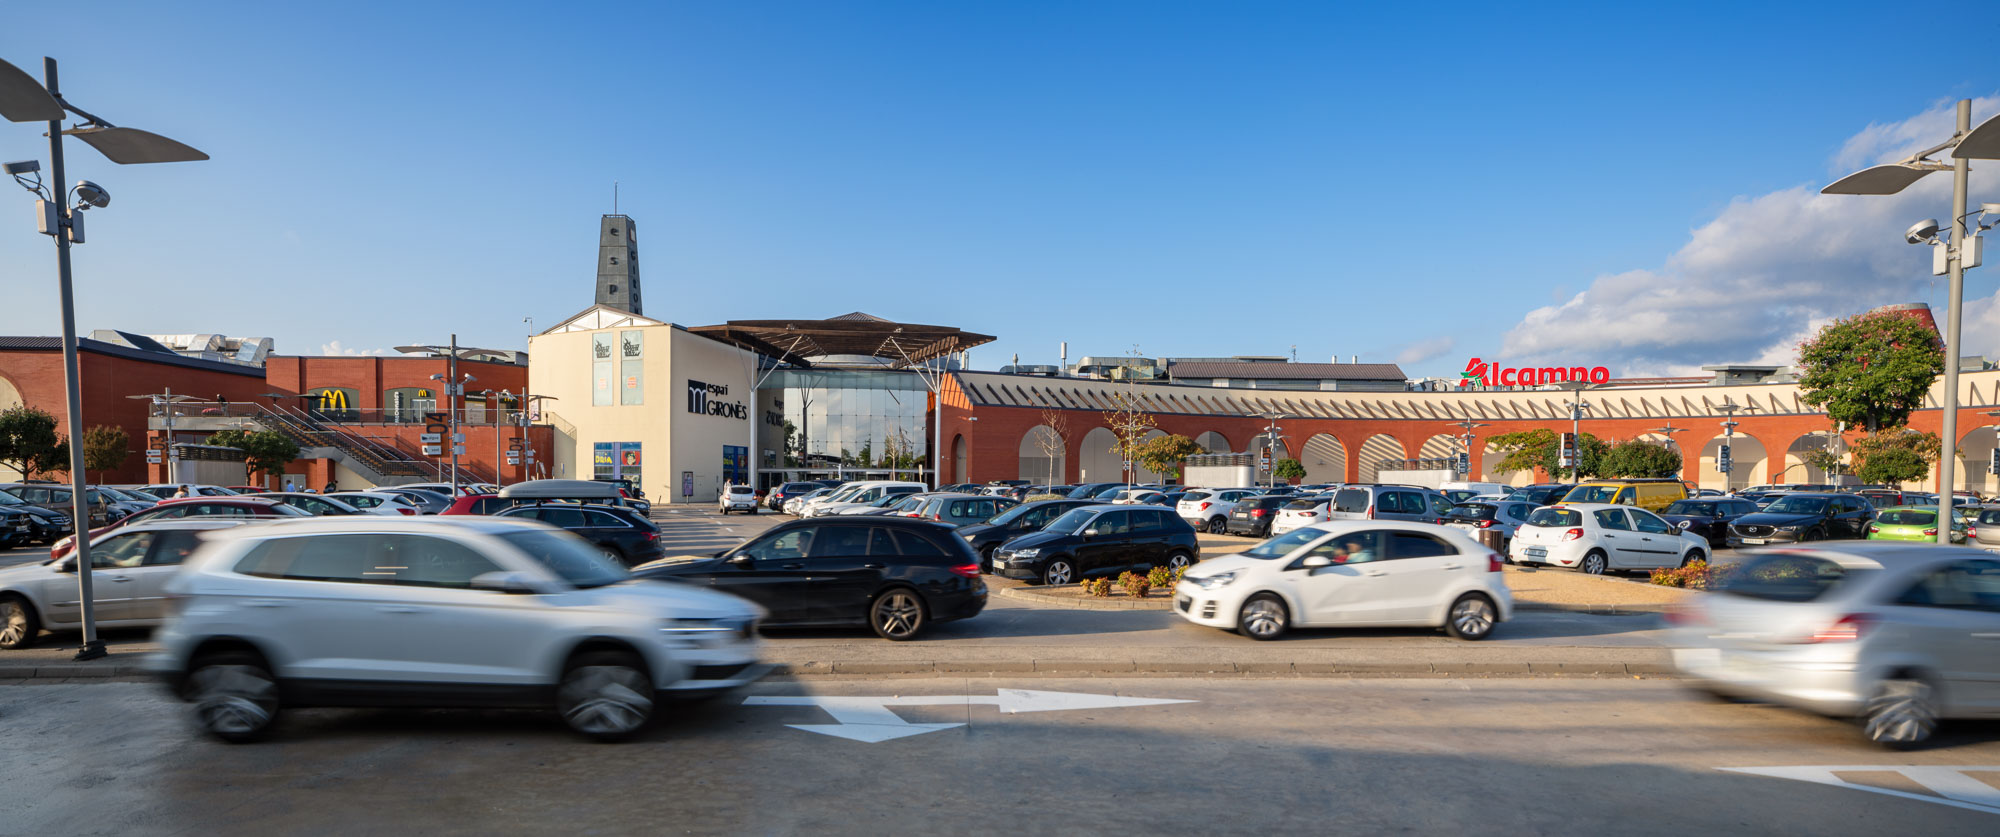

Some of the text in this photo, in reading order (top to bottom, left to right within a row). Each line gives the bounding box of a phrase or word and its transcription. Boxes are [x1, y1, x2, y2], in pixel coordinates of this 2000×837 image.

[1460, 357, 1610, 387] Alcampo
[707, 383, 728, 397] espai
[707, 400, 747, 420] GIRONÈS
[425, 413, 448, 433] 04
[150, 436, 166, 449] 03
[509, 438, 523, 451] 04
